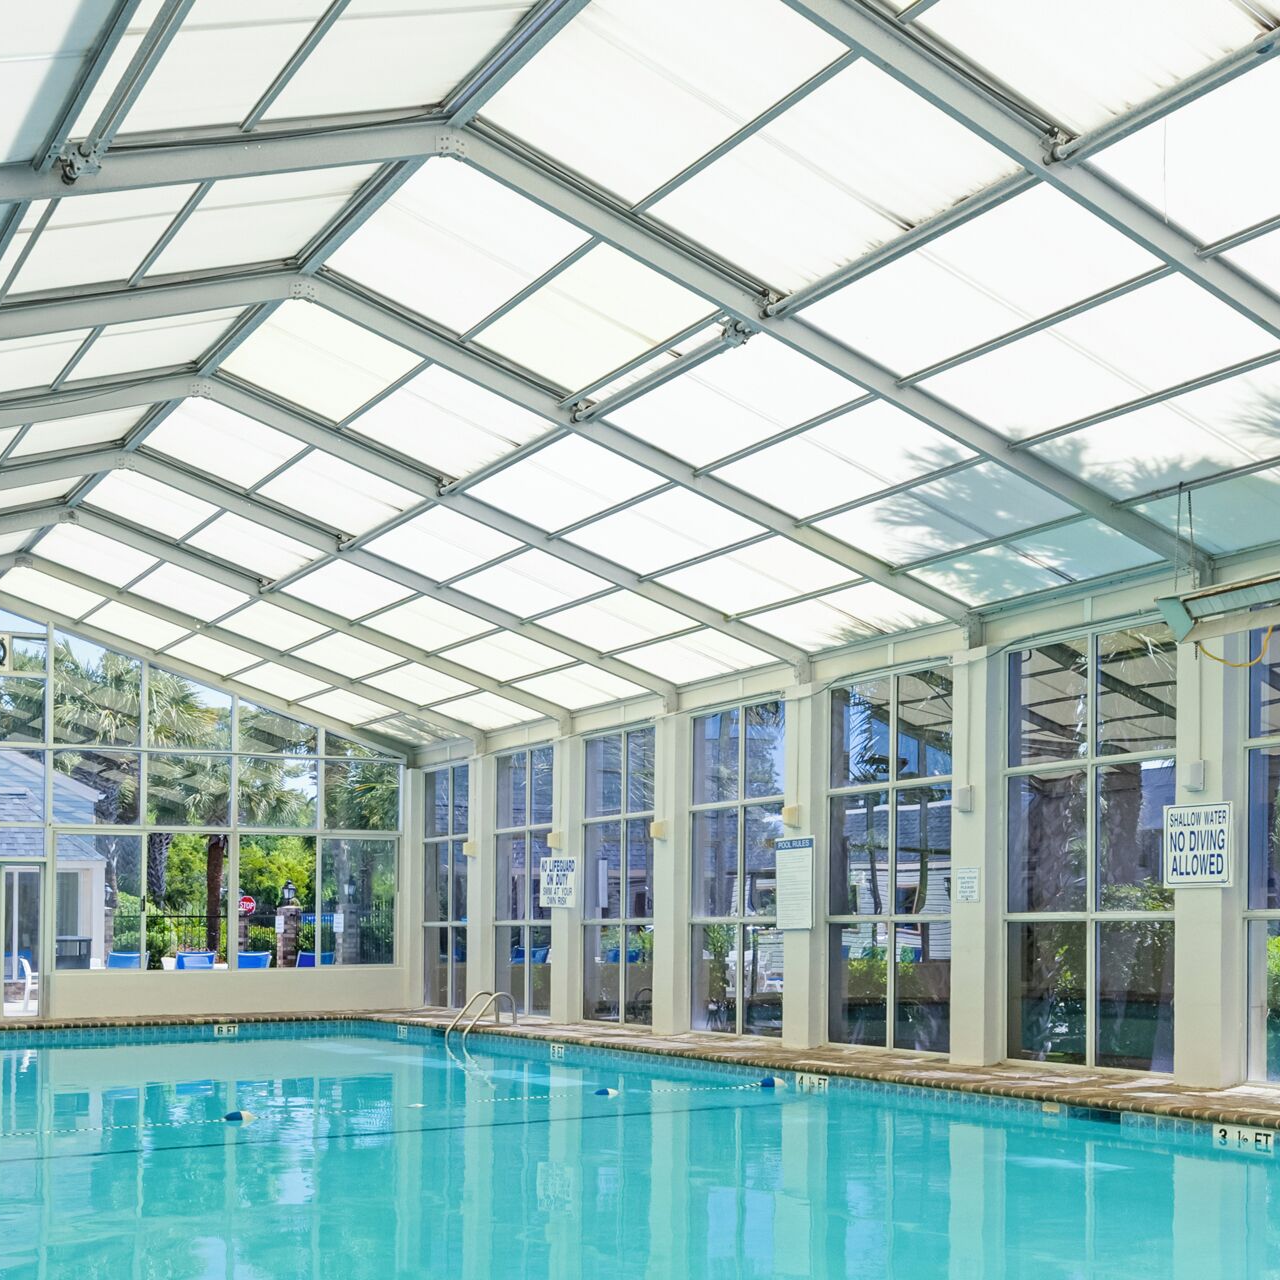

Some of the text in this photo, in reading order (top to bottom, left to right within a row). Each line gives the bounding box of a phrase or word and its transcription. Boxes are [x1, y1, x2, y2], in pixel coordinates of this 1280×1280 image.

[1170, 810, 1226, 827] SHALLOW WATER
[792, 840, 810, 848] RULES
[1170, 829, 1225, 852] NO DIVING
[542, 860, 574, 872] NO LIFEGUARD
[1171, 854, 1223, 876] ALLOWED
[547, 873, 568, 886] ON DUTY
[554, 887, 560, 895] AT
[562, 887, 572, 896] YOUR
[240, 902, 255, 910] STOP
